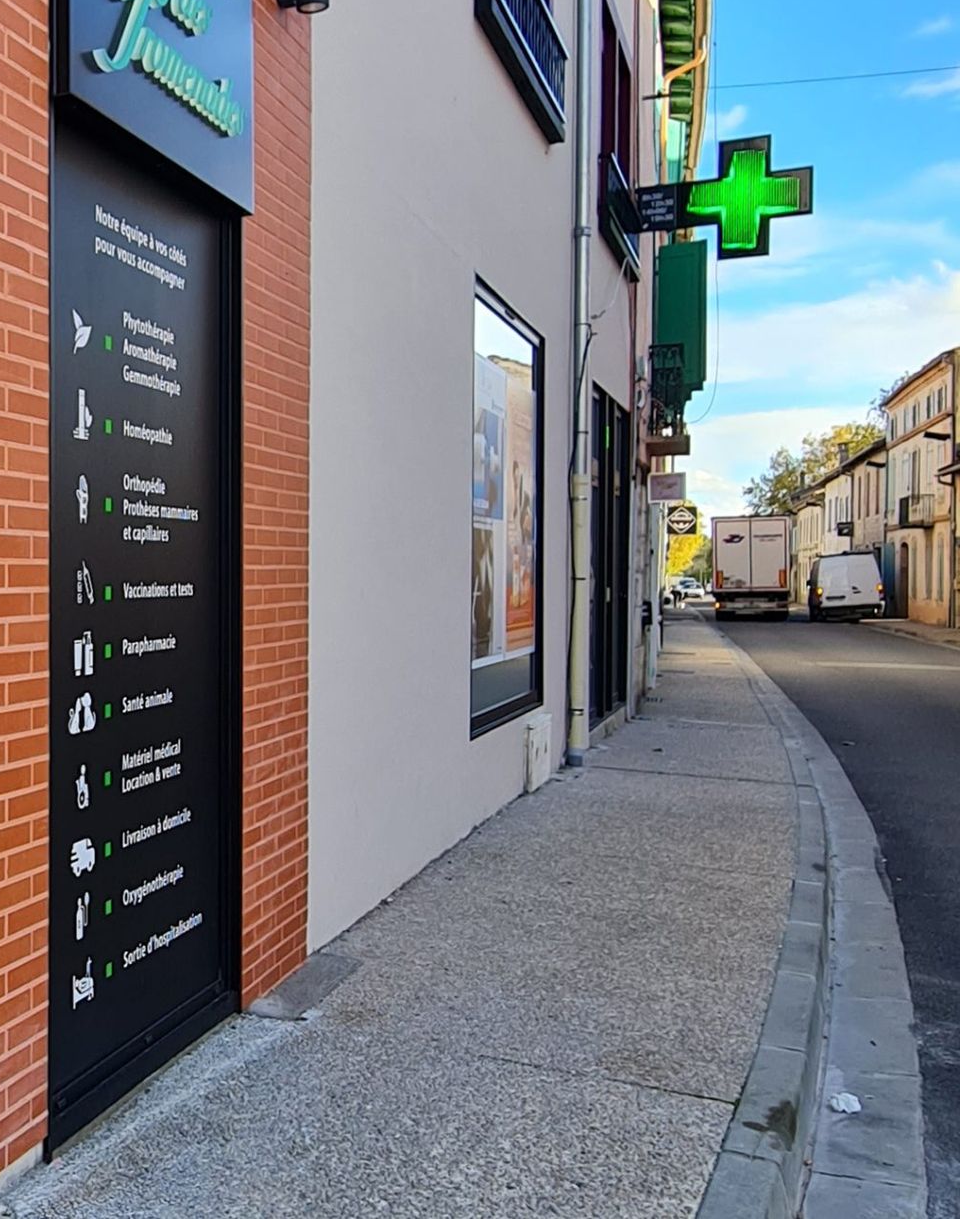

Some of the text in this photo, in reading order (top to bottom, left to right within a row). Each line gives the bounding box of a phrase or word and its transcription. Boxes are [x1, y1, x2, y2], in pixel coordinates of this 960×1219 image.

[95, 204, 187, 268] Notre équipe à vos côtés
[95, 236, 185, 291] pour vous accompagner
[123, 311, 175, 345] Phytothérapie
[123, 338, 178, 372] Aromathérapie
[123, 365, 181, 398] Gemmothérapie
[123, 420, 173, 445] Homéopathie
[123, 474, 166, 497] Orthopédie
[123, 498, 199, 521] Prothèses mammaires
[123, 524, 170, 545] et capillaires
[123, 582, 194, 599] Vaccinations et tests
[122, 633, 177, 657] Parapharmacie
[122, 688, 174, 713] Santé animale
[121, 738, 182, 771] Matériel médical
[121, 762, 181, 793] Location & vente
[122, 807, 192, 848] Livraison à domicile
[122, 864, 184, 906] Oxygénothérapie
[123, 912, 203, 968] Sortie d'hospitalisation
